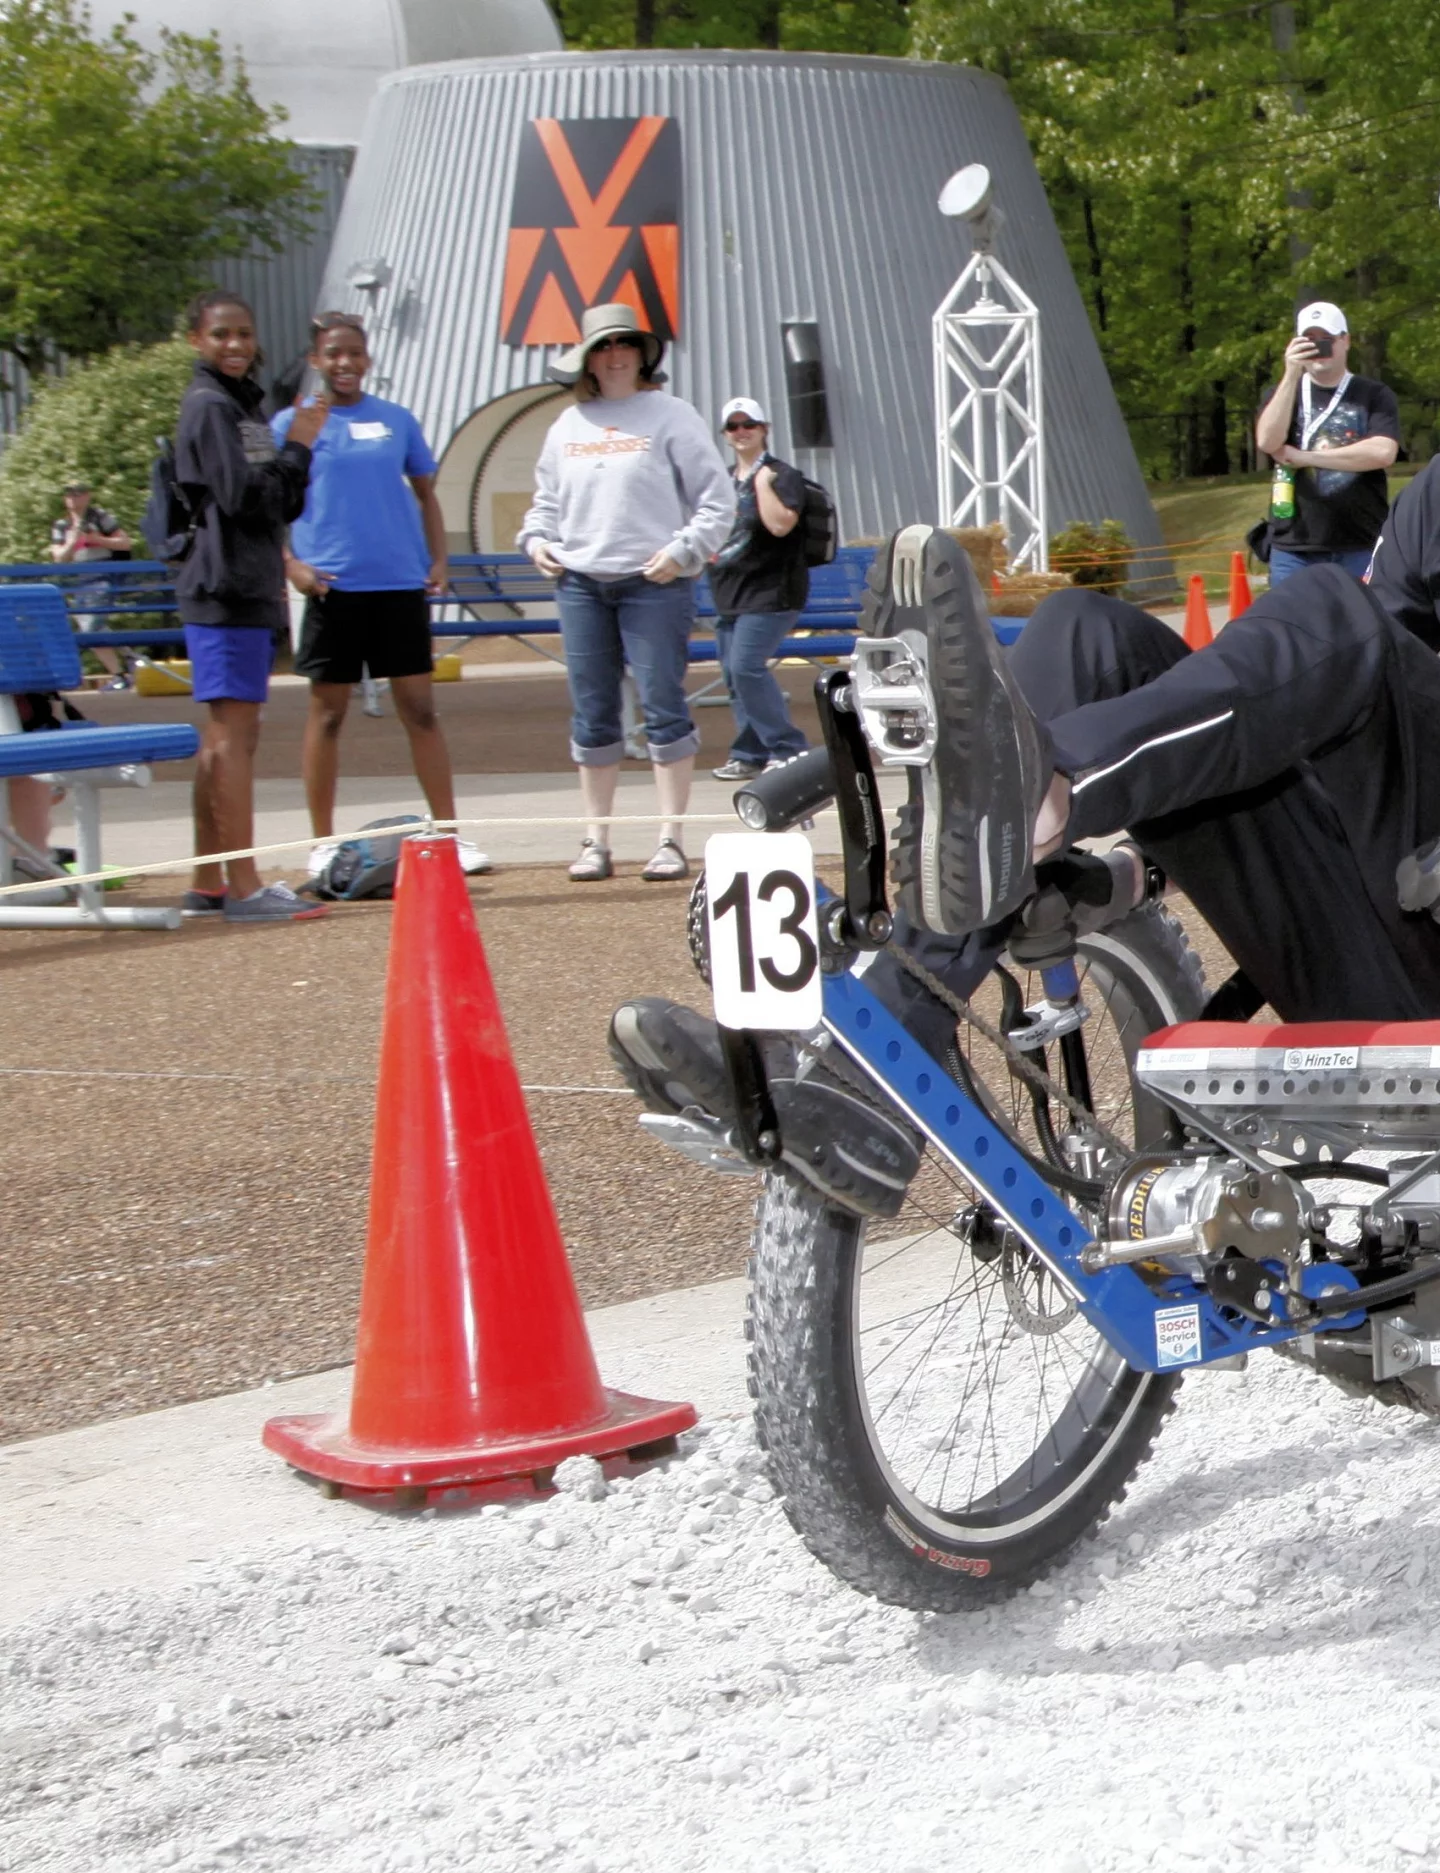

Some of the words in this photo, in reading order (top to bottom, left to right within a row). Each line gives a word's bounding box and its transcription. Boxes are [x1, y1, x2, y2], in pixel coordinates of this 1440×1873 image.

[712, 869, 818, 994] 13
[1304, 1053, 1354, 1067] HinzTec
[1159, 1317, 1197, 1334] BOSCH
[1159, 1331, 1197, 1345] Service
